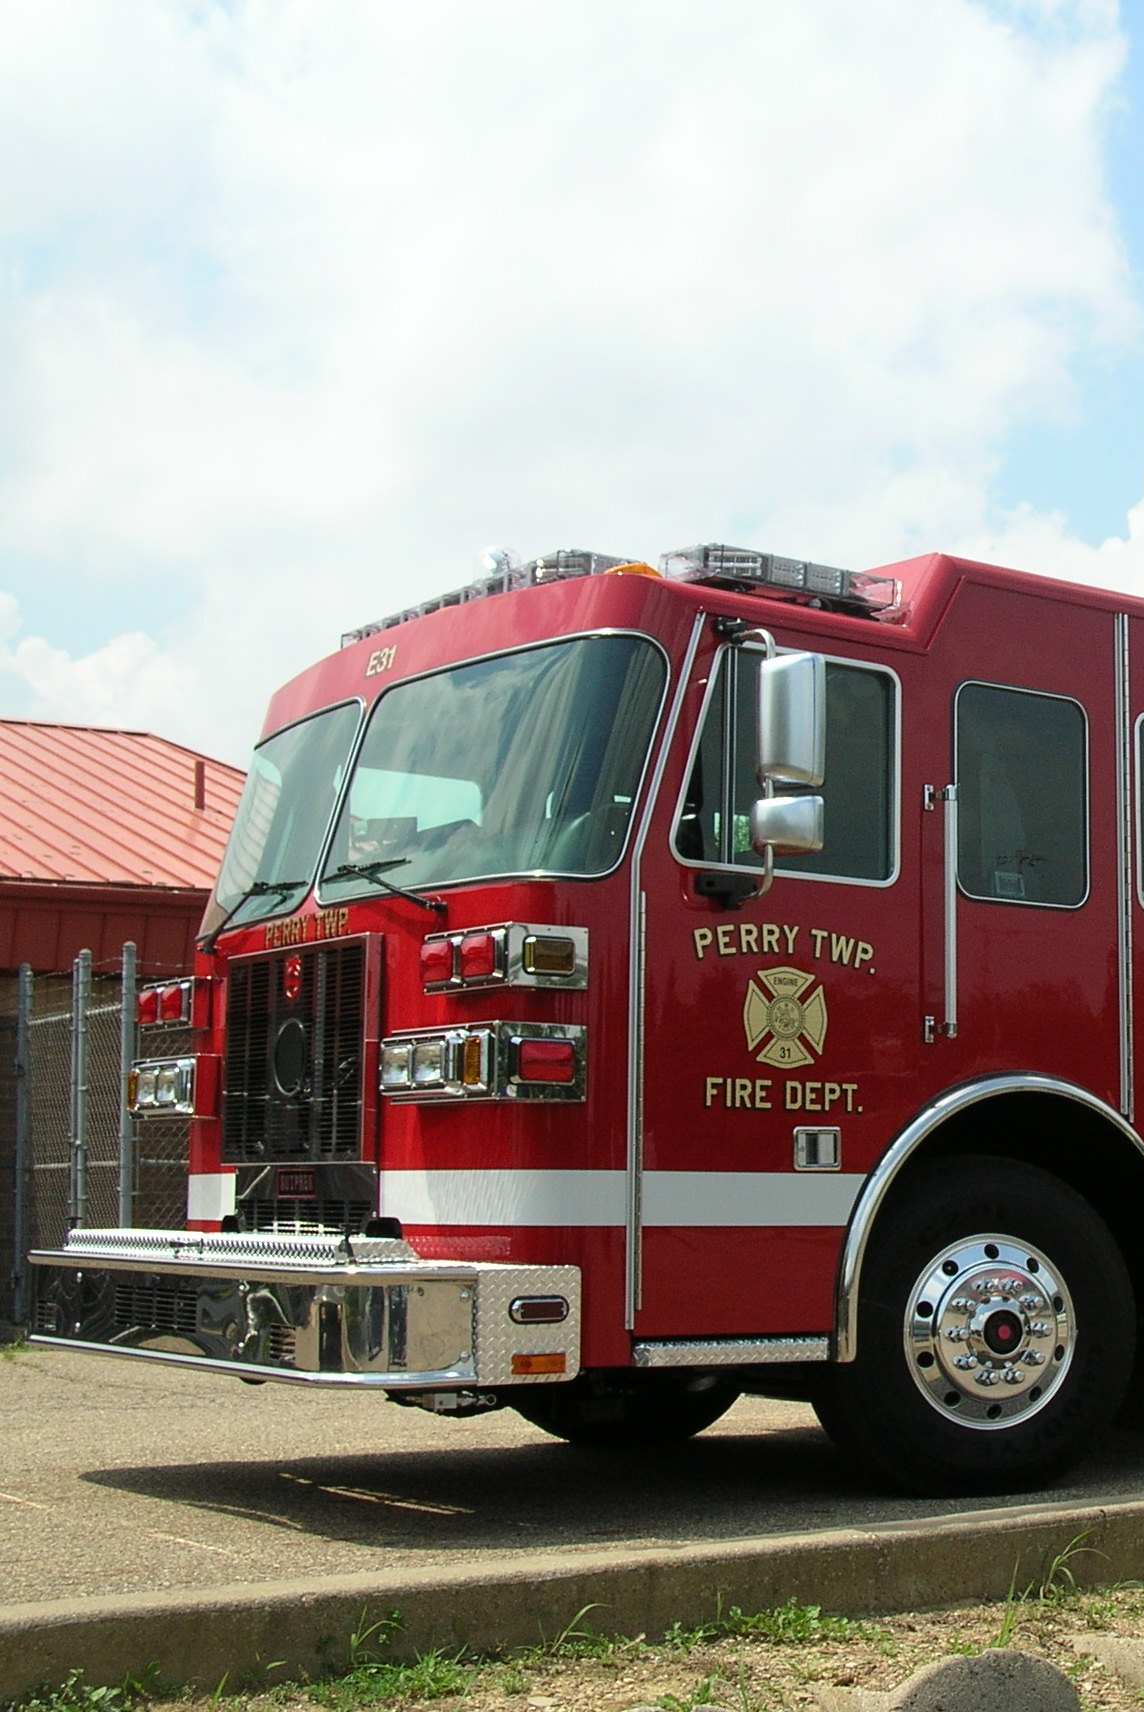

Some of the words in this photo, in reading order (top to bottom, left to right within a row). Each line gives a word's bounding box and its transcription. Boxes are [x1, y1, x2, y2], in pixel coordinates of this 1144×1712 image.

[366, 644, 397, 677] E31
[265, 915, 309, 948] PERRY
[315, 908, 351, 940] TWP.
[693, 924, 800, 961] PERRY
[810, 928, 876, 975] TWP.
[773, 976, 799, 987] ENGINE
[780, 1046, 791, 1059] 31
[705, 1077, 772, 1109] FIRE
[785, 1080, 864, 1113] DEPT.
